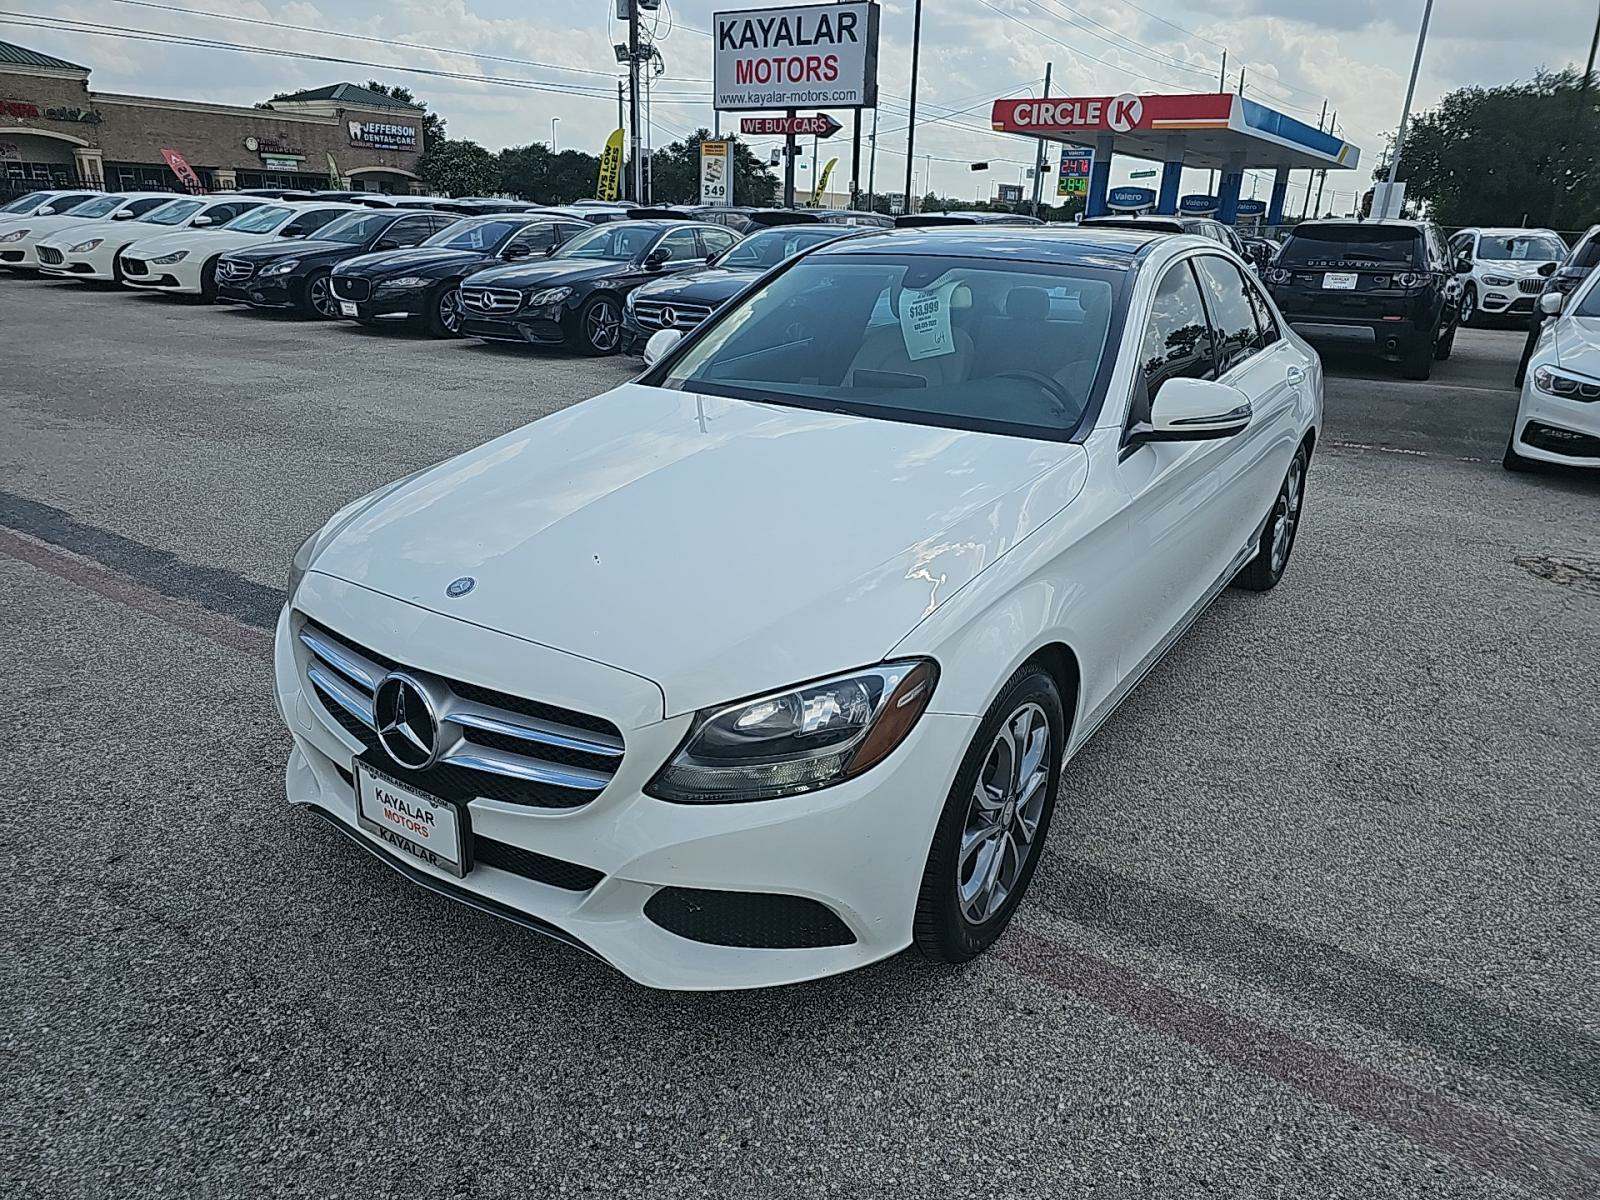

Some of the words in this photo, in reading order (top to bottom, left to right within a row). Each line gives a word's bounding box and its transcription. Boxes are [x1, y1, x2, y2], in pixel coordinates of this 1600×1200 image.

[719, 12, 858, 50] KAYALAR
[736, 54, 839, 85] MOTORS
[720, 89, 857, 106] www.kayalar-motors.com
[743, 119, 762, 132] WE
[765, 119, 790, 132] BUY
[793, 118, 827, 132] CARS
[1013, 101, 1102, 126] CIRCLE
[1112, 98, 1139, 130] K
[363, 122, 415, 137] JEFFERSON
[364, 133, 394, 143] DENTAL
[396, 136, 417, 145] CARE
[603, 145, 611, 172] LOW
[608, 146, 619, 191] PRICES
[1114, 192, 1143, 201] Valero
[1184, 199, 1210, 207] Valero
[909, 300, 939, 319] $13,999
[375, 787, 435, 827] KAYALAR
[384, 808, 429, 838] MOTORS
[380, 825, 441, 867] KAYALAR
